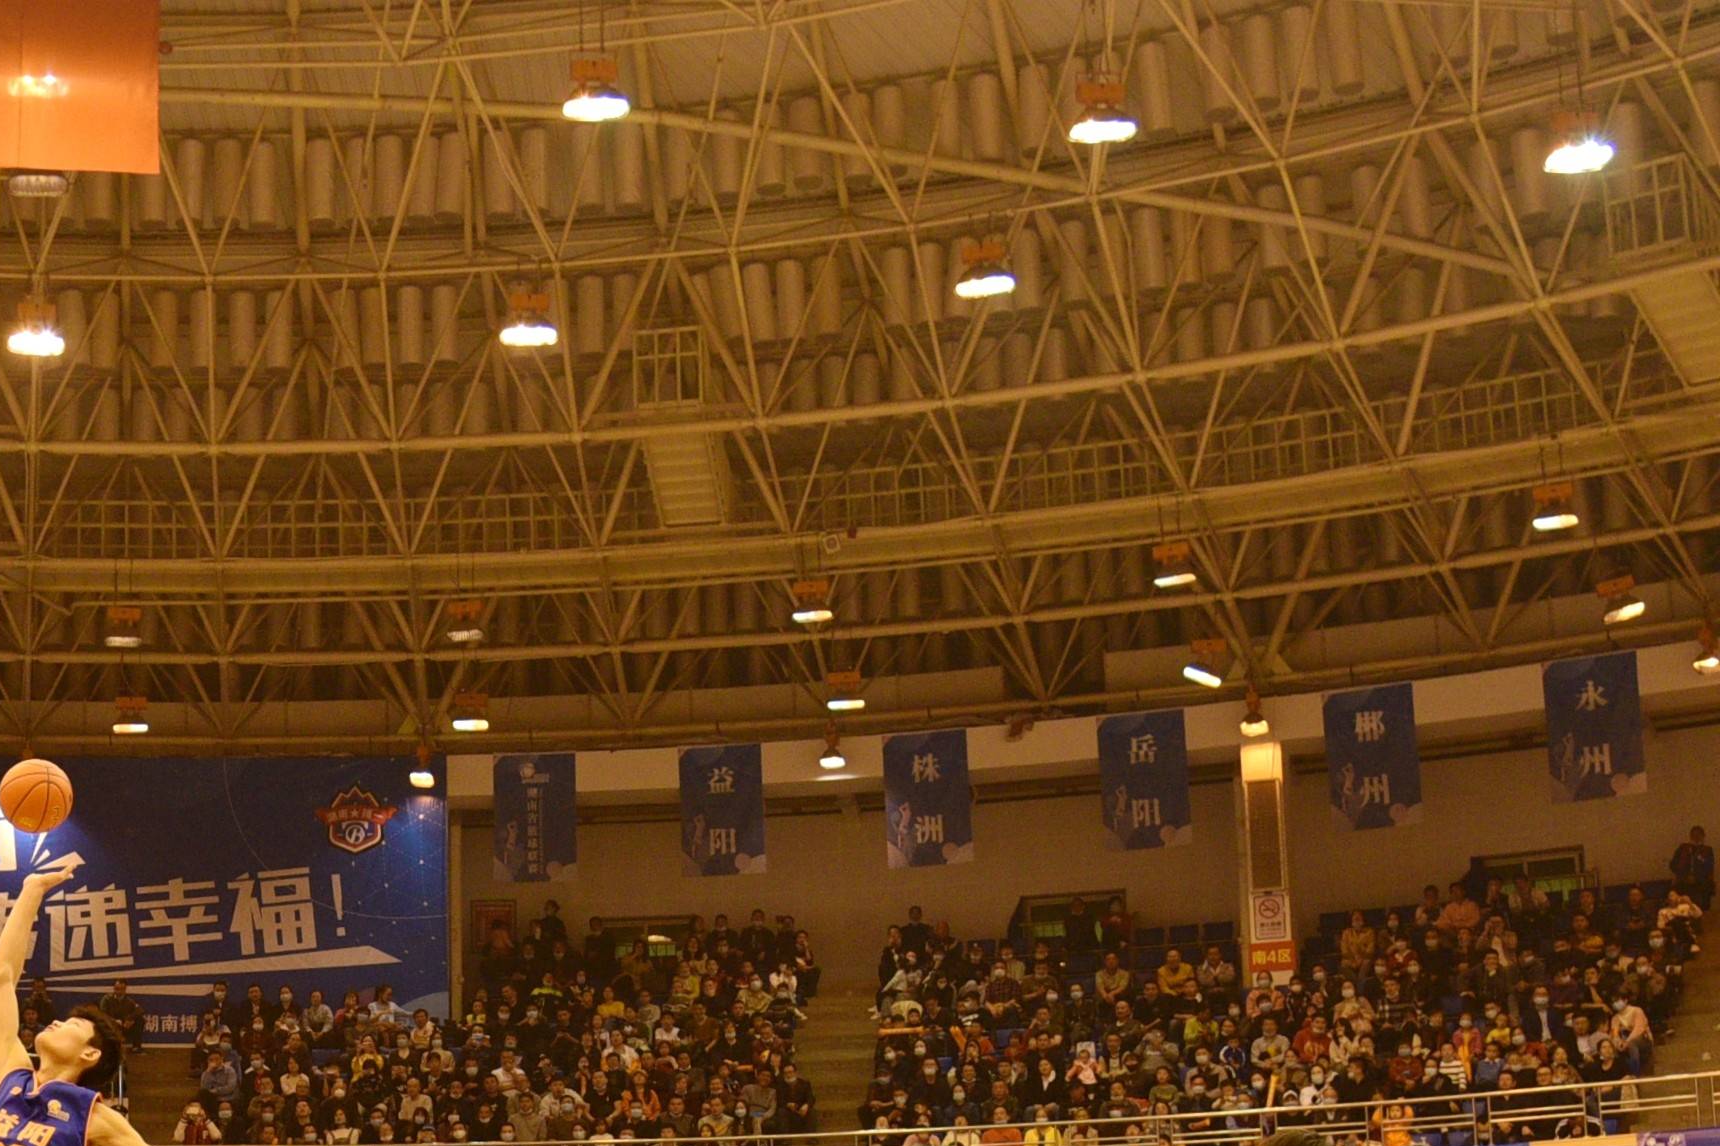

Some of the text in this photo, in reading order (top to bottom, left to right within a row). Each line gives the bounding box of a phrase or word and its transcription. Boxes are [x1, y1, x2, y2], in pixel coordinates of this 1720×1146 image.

[1355, 711, 1389, 808] 郴州
[1576, 680, 1612, 778] 永州
[707, 767, 736, 855] 益阳
[912, 753, 943, 844] 株洲
[1130, 734, 1161, 827] 岳阳
